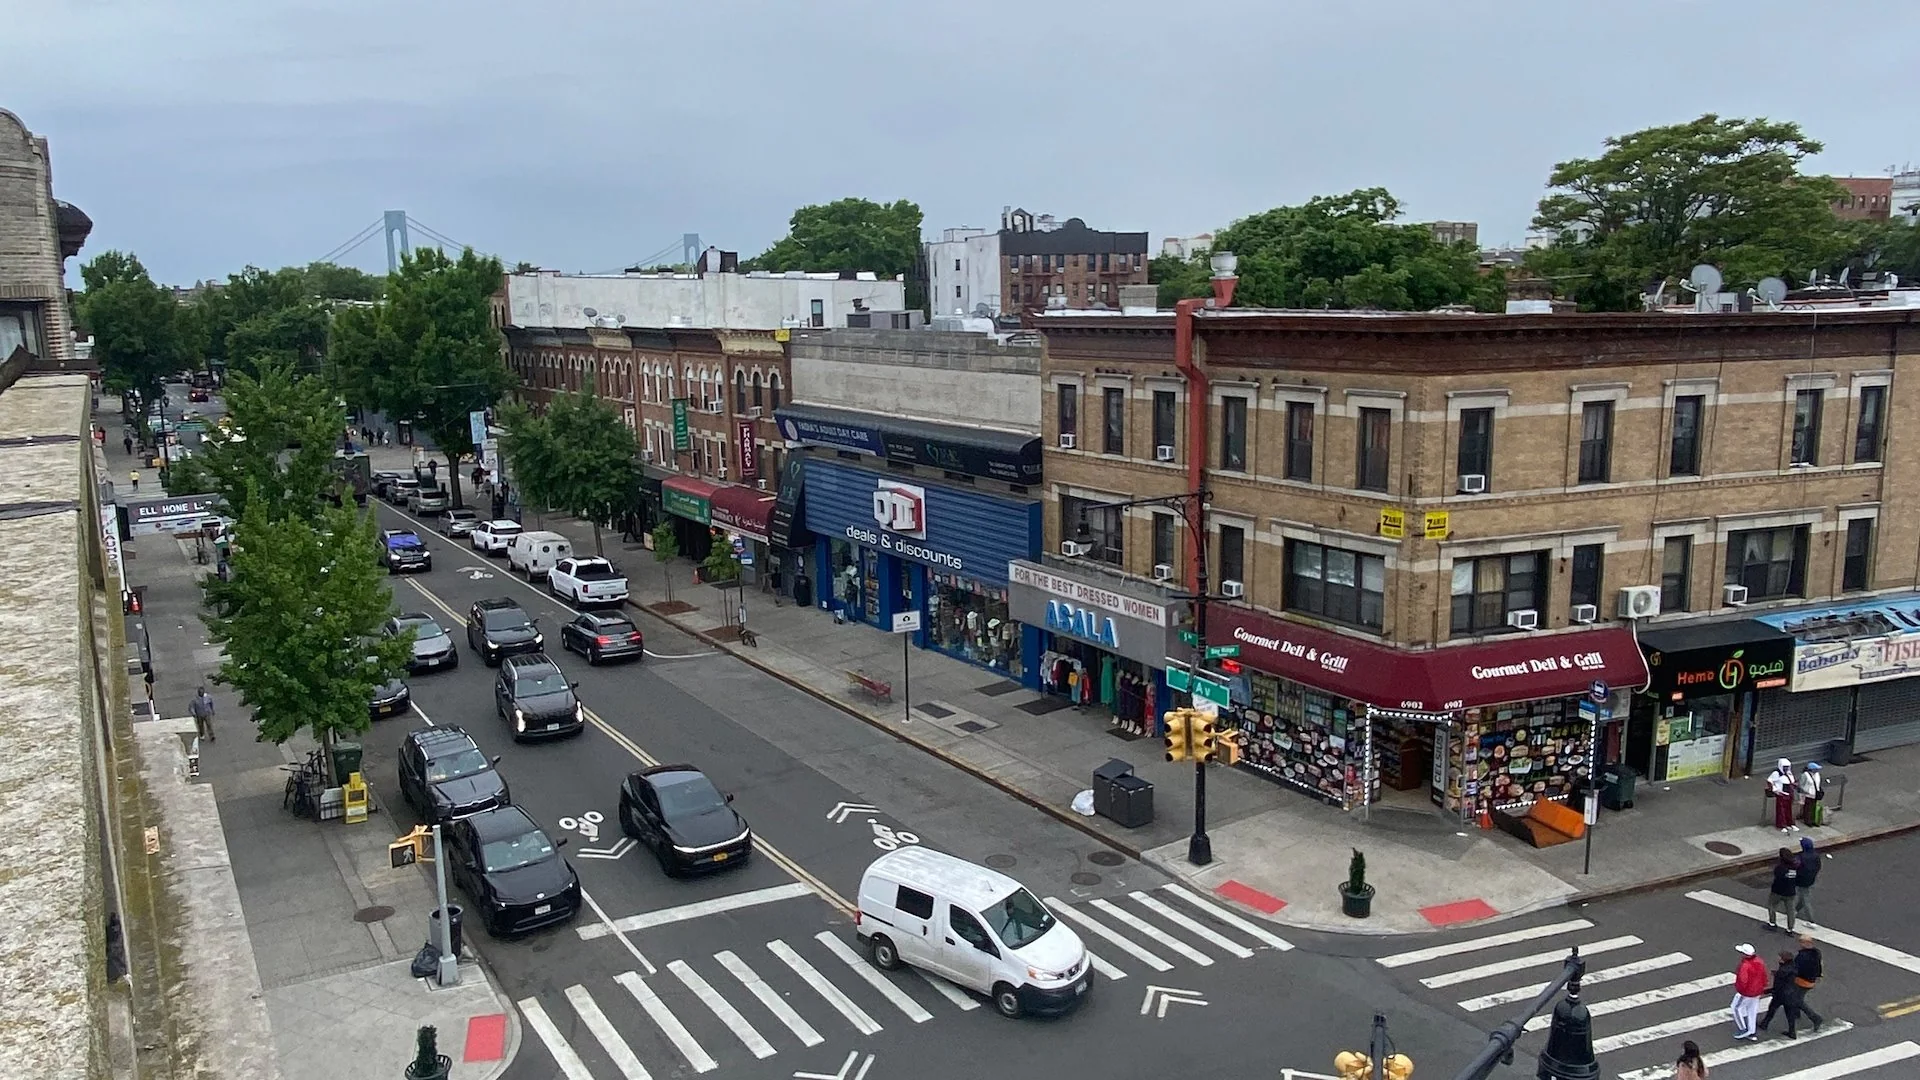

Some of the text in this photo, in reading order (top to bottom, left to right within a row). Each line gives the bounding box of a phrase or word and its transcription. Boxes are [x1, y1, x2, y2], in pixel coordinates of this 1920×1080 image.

[846, 525, 962, 570] deals & discounts
[1014, 567, 1160, 621] FOR THE BEST DRESSED WOMEN
[1045, 600, 1119, 649] ASALA
[1234, 627, 1279, 651] Gourmet
[1281, 640, 1305, 658] Deli
[1306, 647, 1318, 661] &
[1320, 651, 1349, 670] Grill
[1471, 664, 1529, 680] Gourmet
[1529, 657, 1558, 673] Deli
[1559, 655, 1572, 669] &
[1573, 651, 1604, 667] Grill
[1194, 682, 1212, 697] Av
[1677, 670, 1715, 686] Hemo
